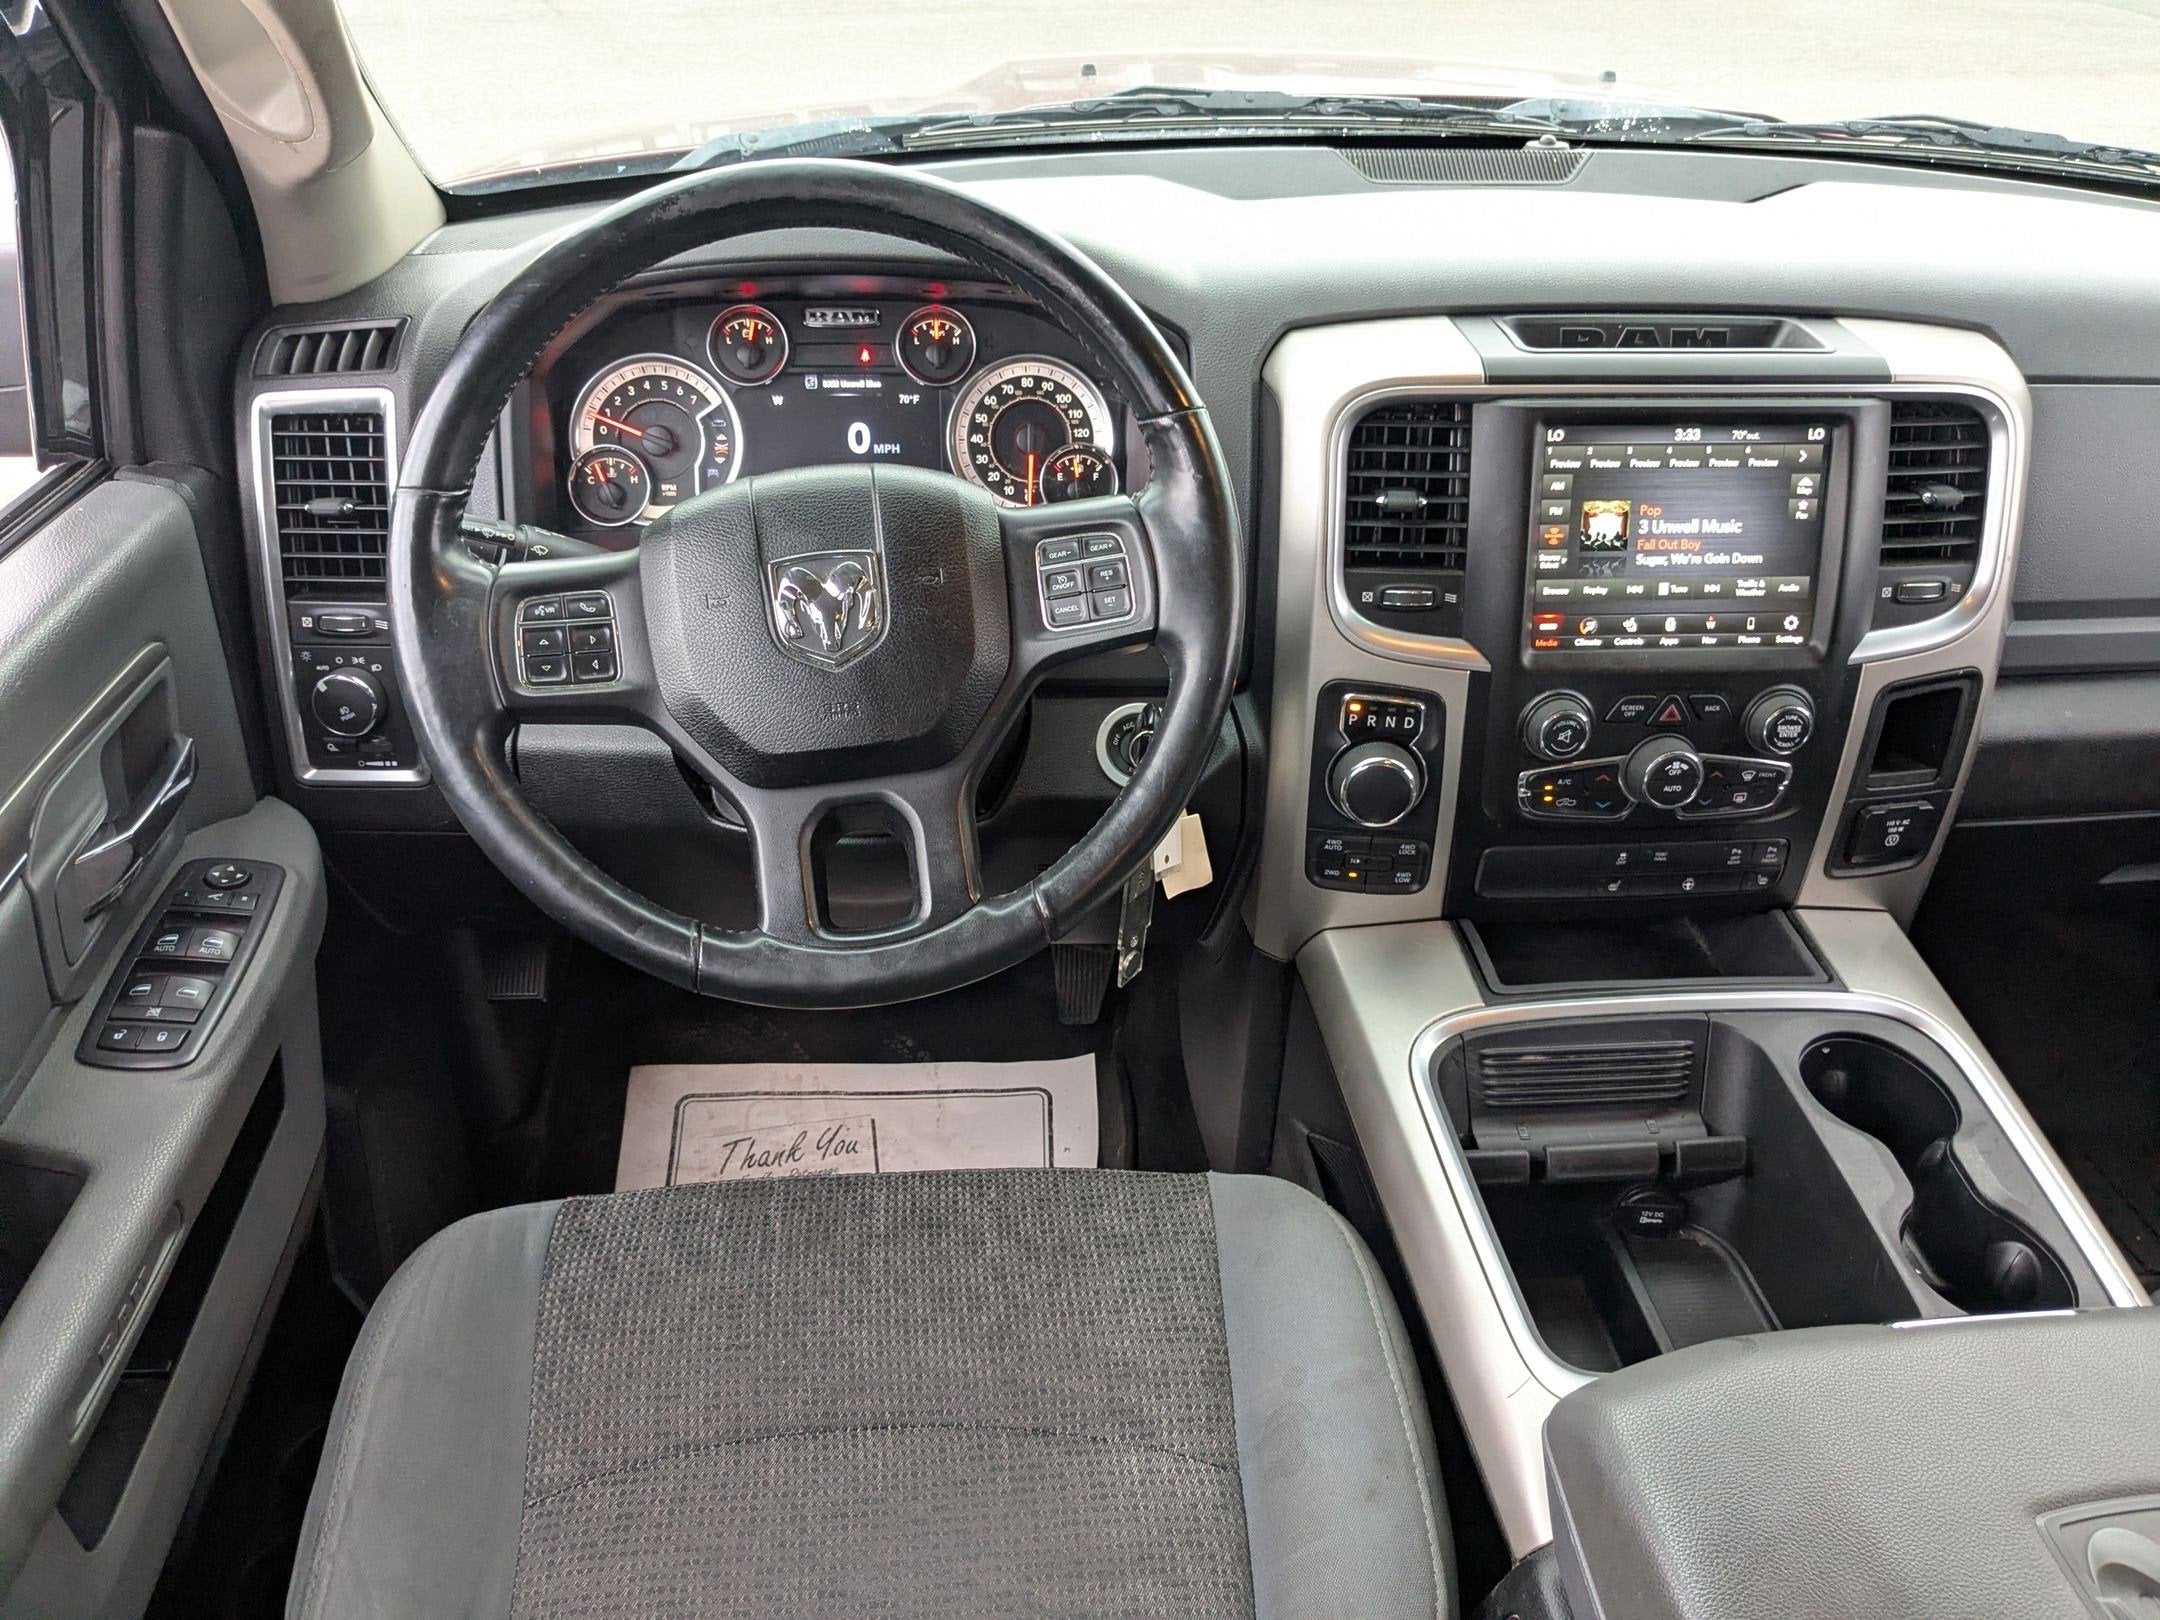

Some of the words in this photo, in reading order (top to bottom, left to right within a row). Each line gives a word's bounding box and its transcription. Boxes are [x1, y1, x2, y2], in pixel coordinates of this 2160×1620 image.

[809, 311, 875, 322] RAM
[914, 336, 920, 345] L
[952, 337, 960, 345] H
[643, 381, 650, 390] 4
[661, 381, 668, 390] 5
[1021, 377, 1034, 388] 80
[1041, 382, 1054, 392] 90
[628, 386, 635, 396] 3
[677, 386, 684, 395] 6
[1001, 385, 1014, 395] 70
[615, 397, 622, 405] 2
[690, 395, 697, 404] 7
[771, 395, 784, 405] W
[984, 396, 997, 405] 60
[1055, 394, 1072, 404] 100
[605, 408, 610, 416] 1
[1068, 409, 1083, 419] 110
[975, 414, 988, 423] 50
[600, 426, 607, 434] 0
[1073, 428, 1090, 437] 120
[1807, 427, 1826, 441] LO
[848, 422, 871, 454] 0
[873, 444, 900, 454] MPH
[970, 434, 983, 443] 40
[1547, 428, 1565, 442] LO
[1674, 428, 1701, 442] 3:33
[976, 455, 988, 464] 30
[588, 476, 595, 485] C
[630, 476, 638, 484] H
[988, 472, 1000, 481] 20
[1003, 486, 1014, 495] 10
[1640, 504, 1662, 518] Pop
[1638, 519, 1649, 534] 3
[1651, 518, 1700, 534] Unwell
[1701, 518, 1743, 534] Music
[1637, 539, 1656, 550] Fall
[1658, 539, 1678, 550] Out
[1680, 538, 1702, 551] Boy
[1731, 552, 1764, 564] Down
[1100, 569, 1114, 577] RES
[1104, 596, 1116, 604] SET
[1055, 605, 1080, 614] CANCEL
[1535, 639, 1558, 647] Media
[1348, 715, 1358, 726] P
[1367, 716, 1377, 727] R
[1385, 717, 1396, 728] N
[1403, 717, 1415, 729] D
[199, 946, 221, 955] AUTO
[720, 1130, 808, 1175] Thank
[816, 1124, 859, 1160] You
